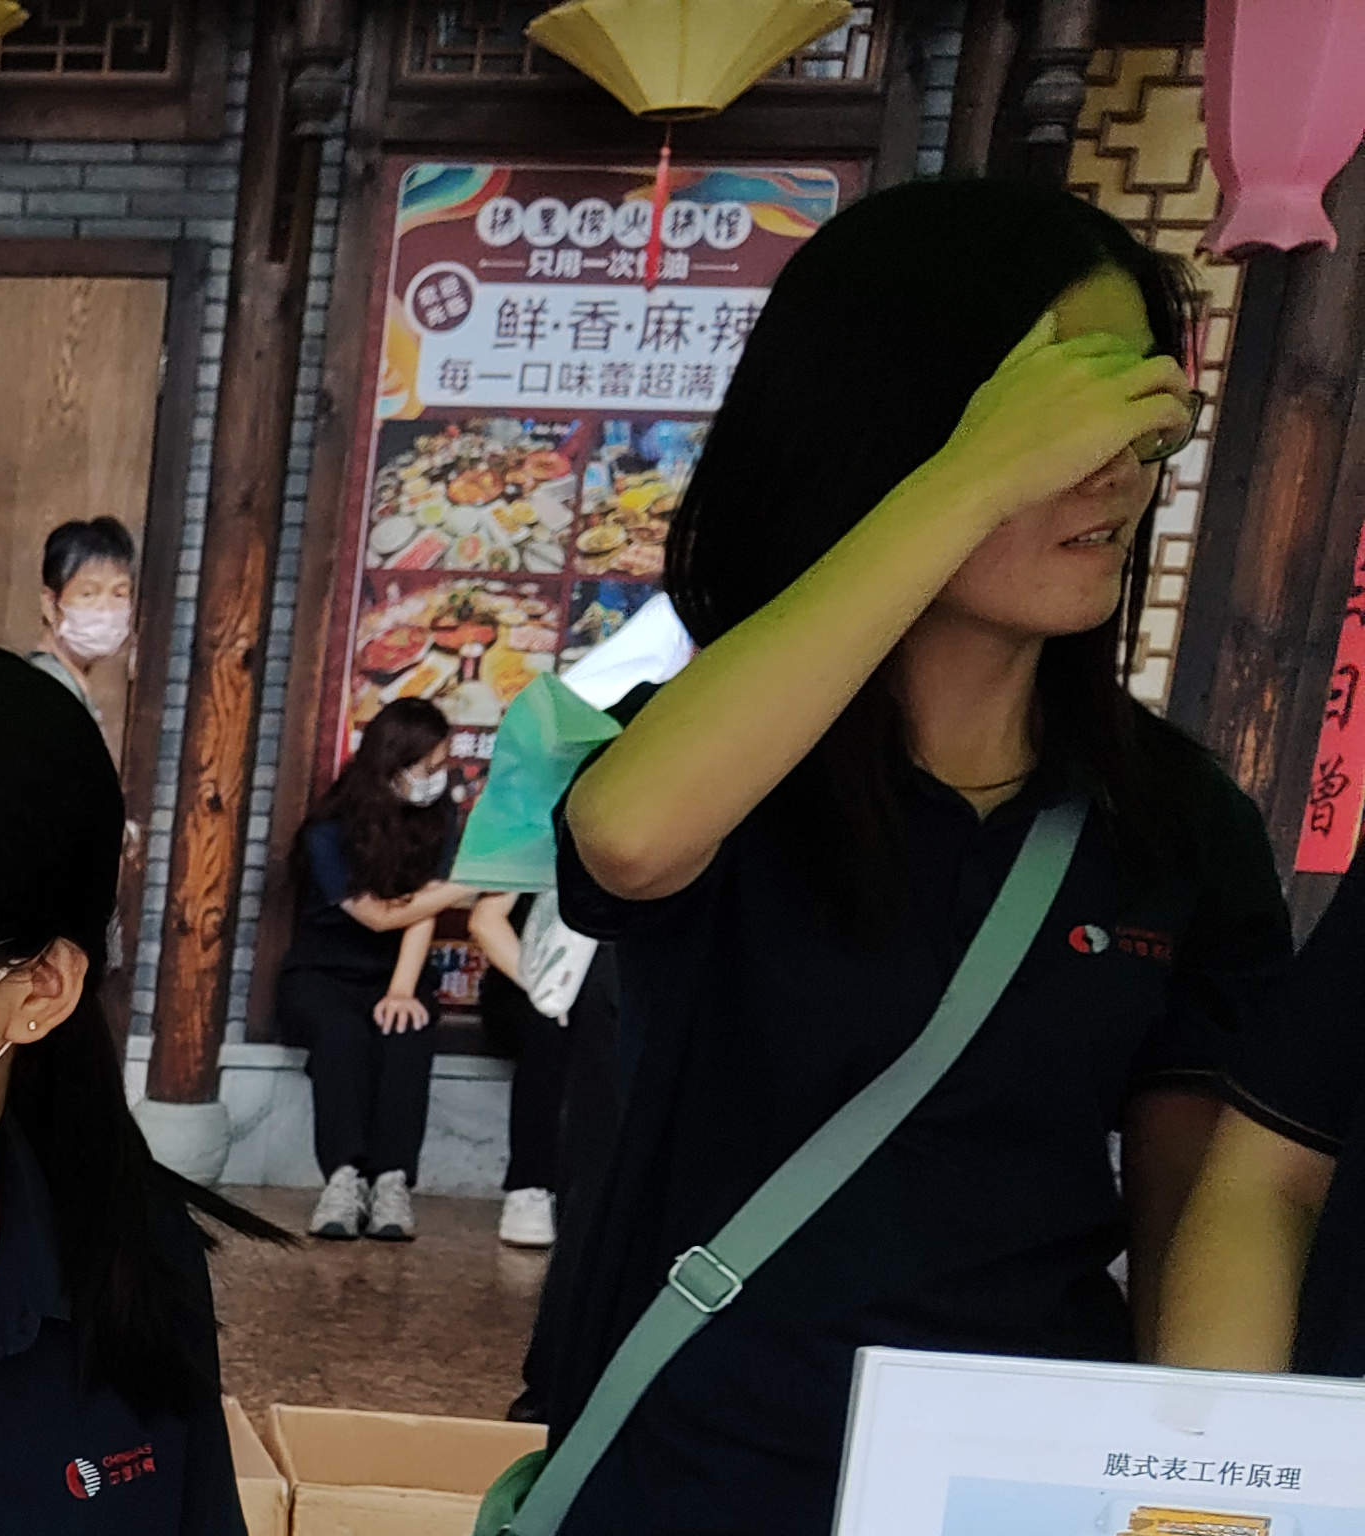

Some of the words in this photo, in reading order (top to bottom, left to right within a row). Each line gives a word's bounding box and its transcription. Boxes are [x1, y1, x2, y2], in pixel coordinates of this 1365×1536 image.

[438, 358, 735, 401] 每一口味蕾超满
[1102, 1452, 1303, 1491] 膜式表工作原理
